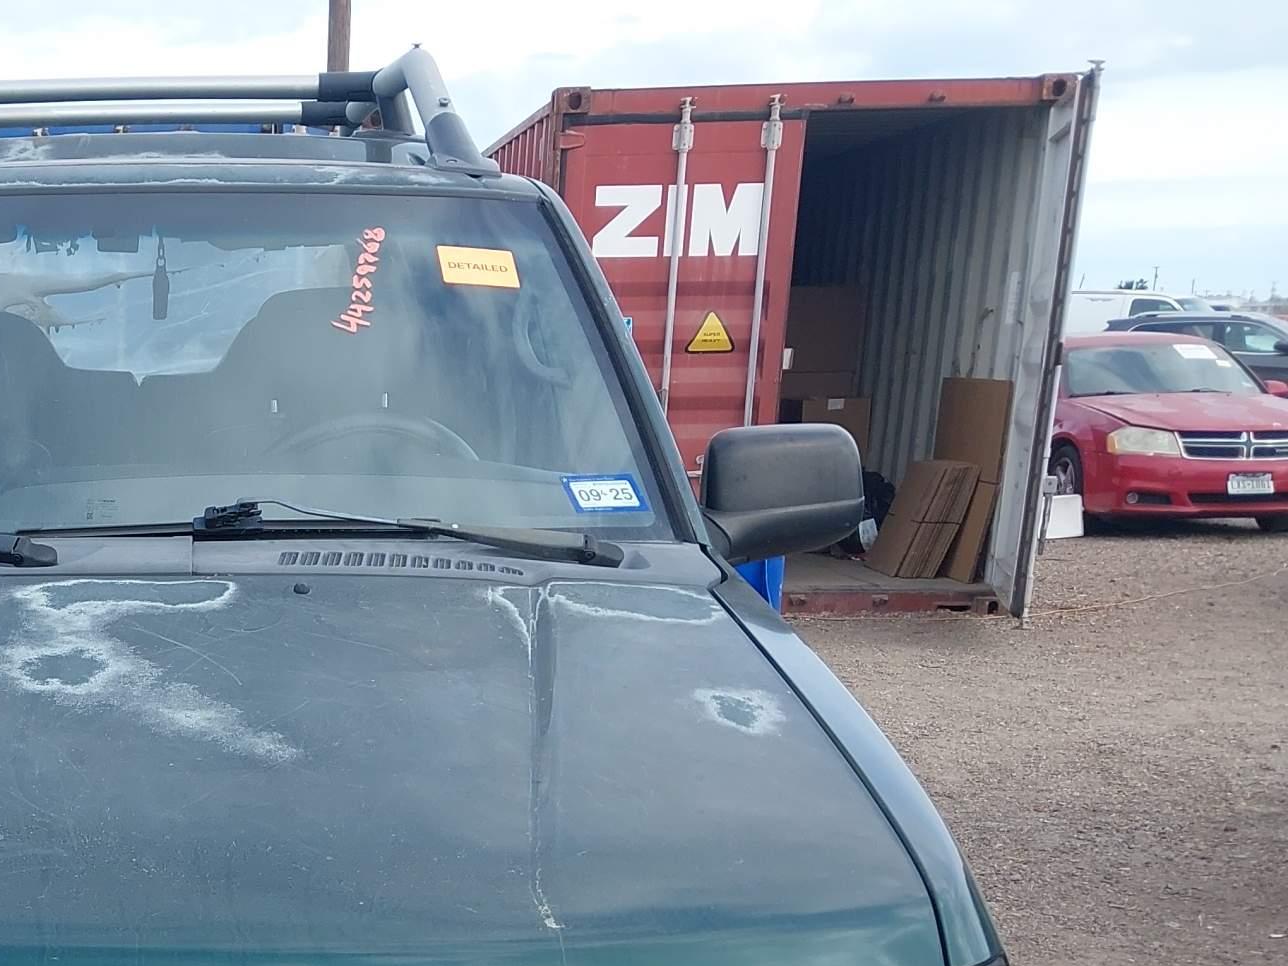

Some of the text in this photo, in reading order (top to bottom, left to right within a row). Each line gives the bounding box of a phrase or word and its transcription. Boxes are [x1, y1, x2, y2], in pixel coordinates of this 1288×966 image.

[592, 182, 765, 258] ZIM
[330, 227, 386, 334] 44259768
[447, 261, 509, 274] DETAILED
